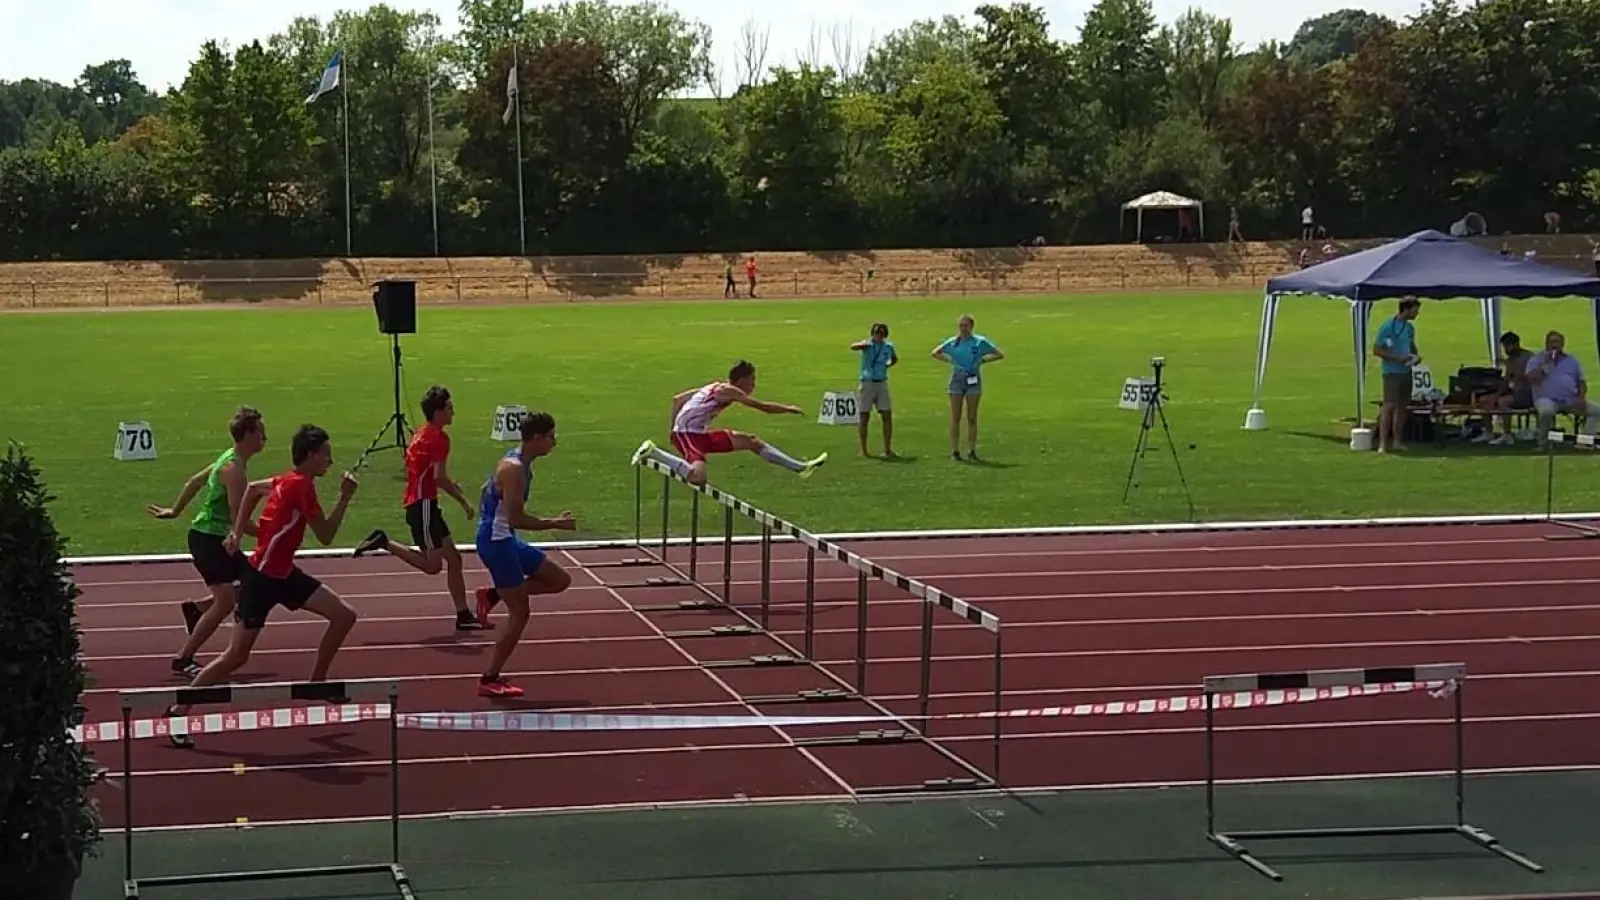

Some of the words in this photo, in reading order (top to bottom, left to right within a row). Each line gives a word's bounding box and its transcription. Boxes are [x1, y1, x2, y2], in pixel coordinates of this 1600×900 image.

[1414, 371, 1431, 389] 50
[1123, 384, 1139, 402] 55
[836, 398, 856, 417] 60
[126, 429, 152, 452] 70
